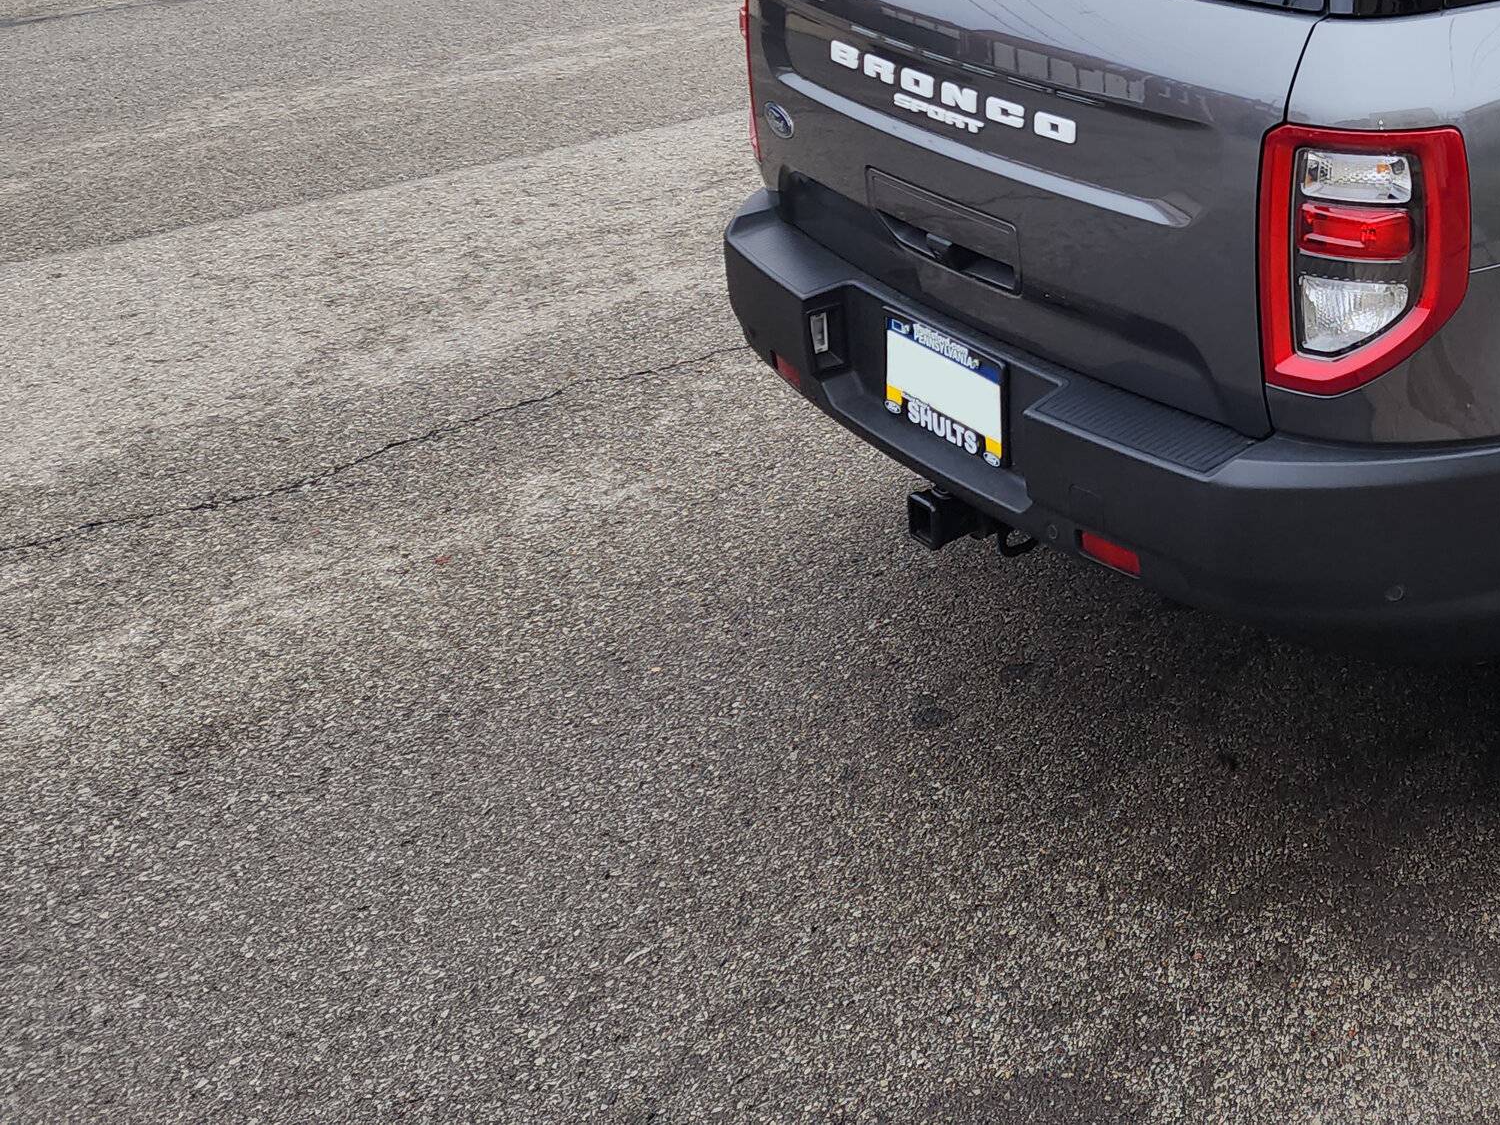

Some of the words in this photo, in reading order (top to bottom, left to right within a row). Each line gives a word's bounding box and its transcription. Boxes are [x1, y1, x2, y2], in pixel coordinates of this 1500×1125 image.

[829, 39, 1078, 145] BRONCO
[893, 92, 985, 134] SPORT
[907, 400, 978, 454] SHULTS
